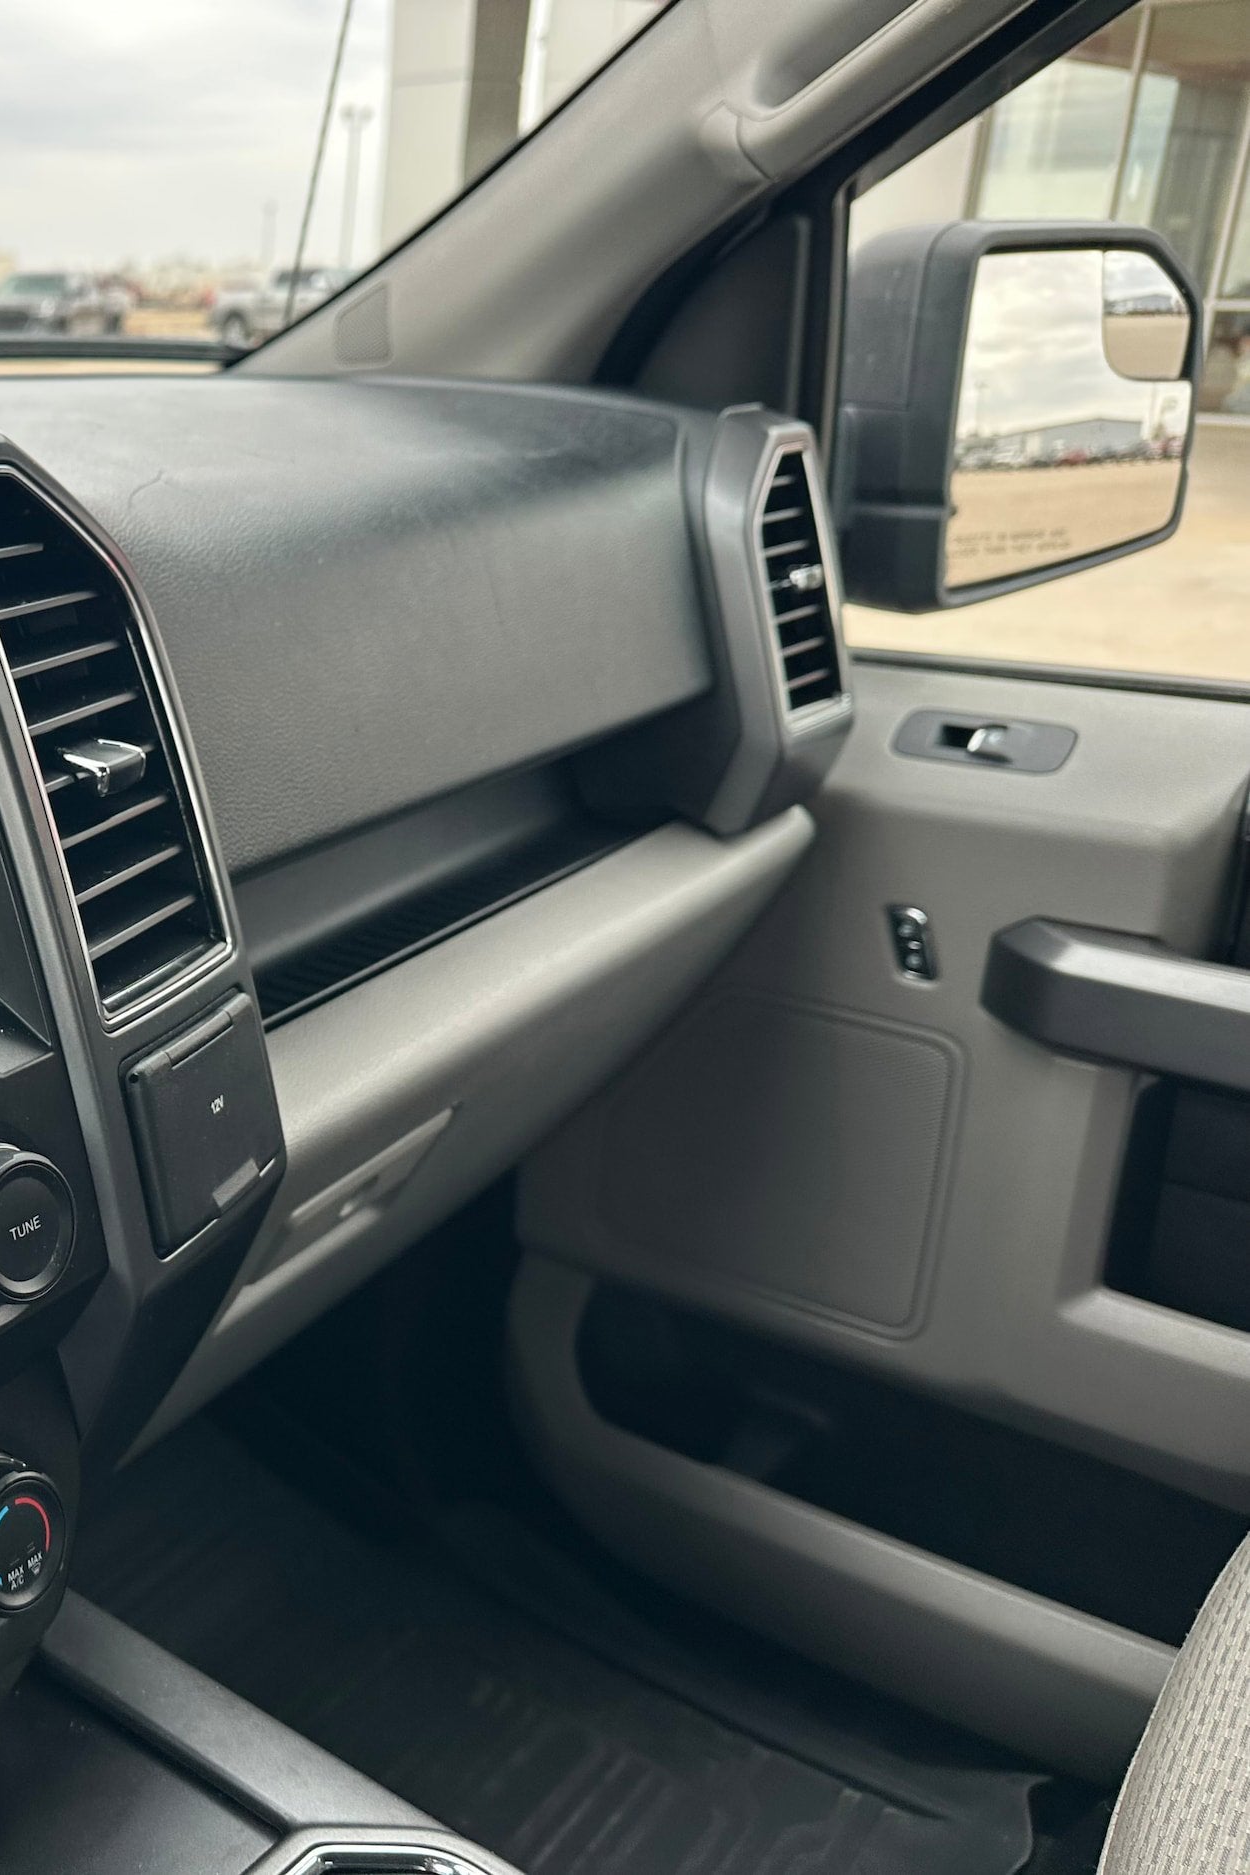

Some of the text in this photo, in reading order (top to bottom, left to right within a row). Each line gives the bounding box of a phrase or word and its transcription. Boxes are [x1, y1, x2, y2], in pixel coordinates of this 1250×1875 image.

[210, 1095, 224, 1114] 12V
[9, 1215, 42, 1240] TUNE
[27, 1551, 42, 1569] MAX
[7, 1564, 24, 1582] MAX
[11, 1575, 25, 1590] A/C
